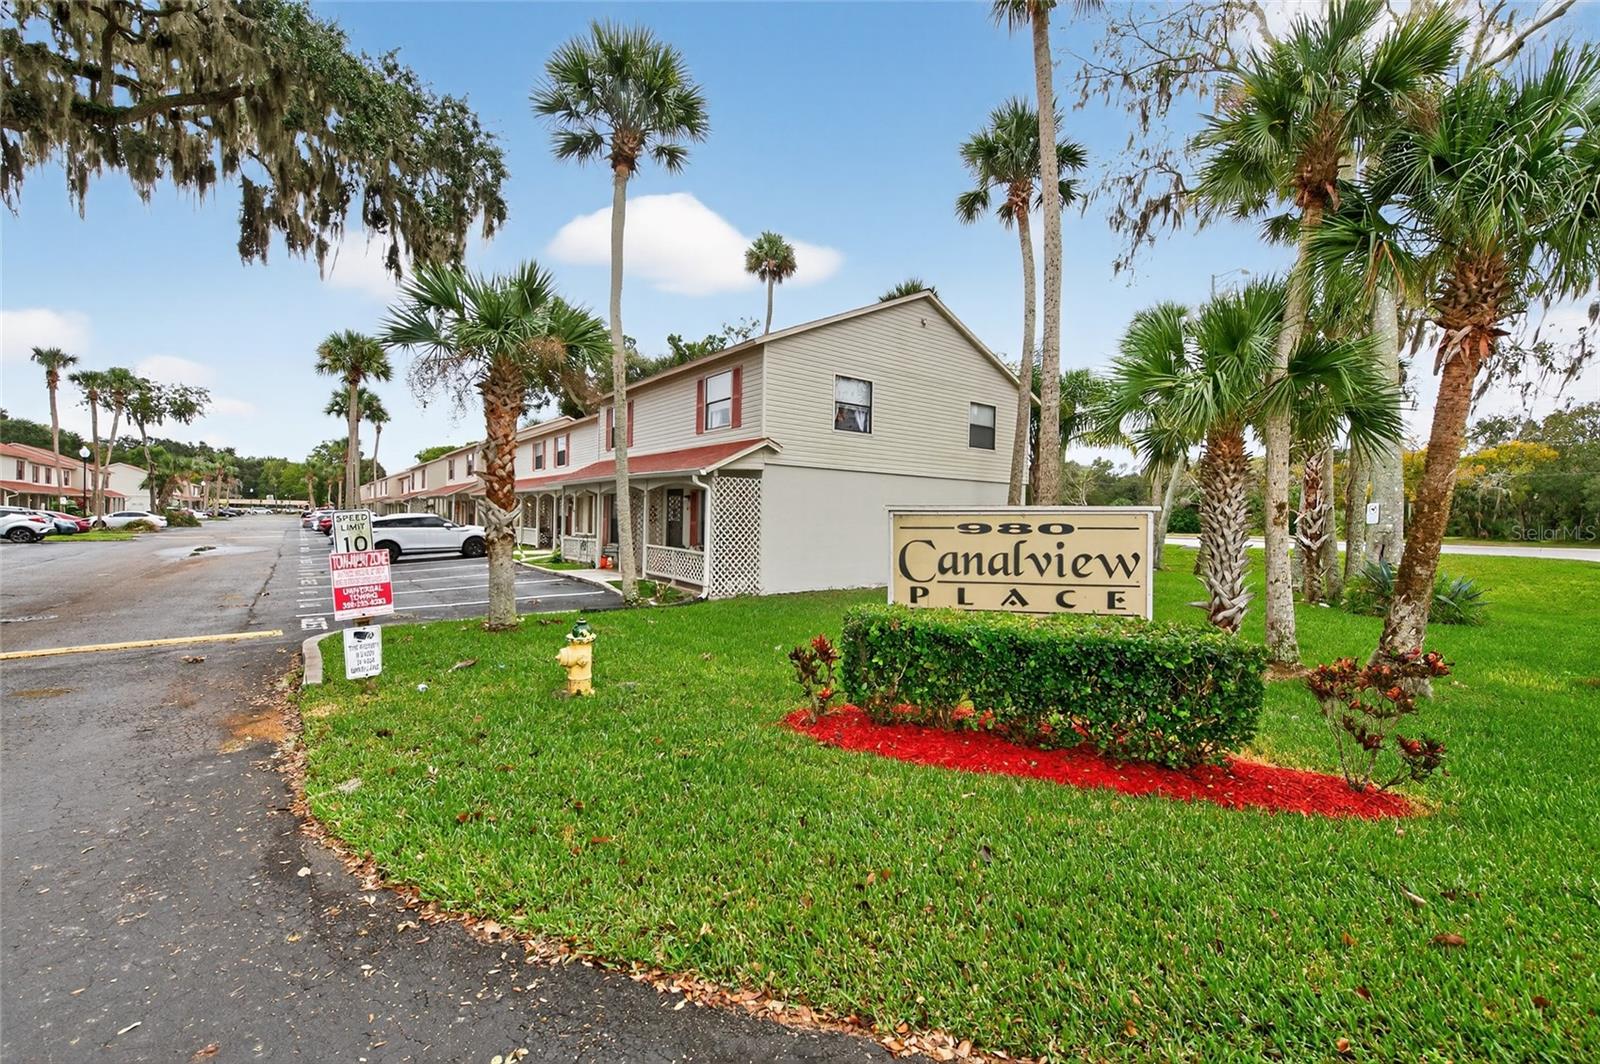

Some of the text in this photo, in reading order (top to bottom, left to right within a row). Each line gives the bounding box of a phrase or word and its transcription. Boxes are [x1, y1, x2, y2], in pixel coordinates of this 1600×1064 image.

[336, 513, 368, 522] SPEED
[340, 523, 365, 532] LIMIT
[957, 522, 1075, 535] 980
[343, 535, 368, 553] 10
[370, 551, 389, 566] ZONE
[898, 539, 1141, 583] Canalview
[910, 586, 1127, 610] PLACE
